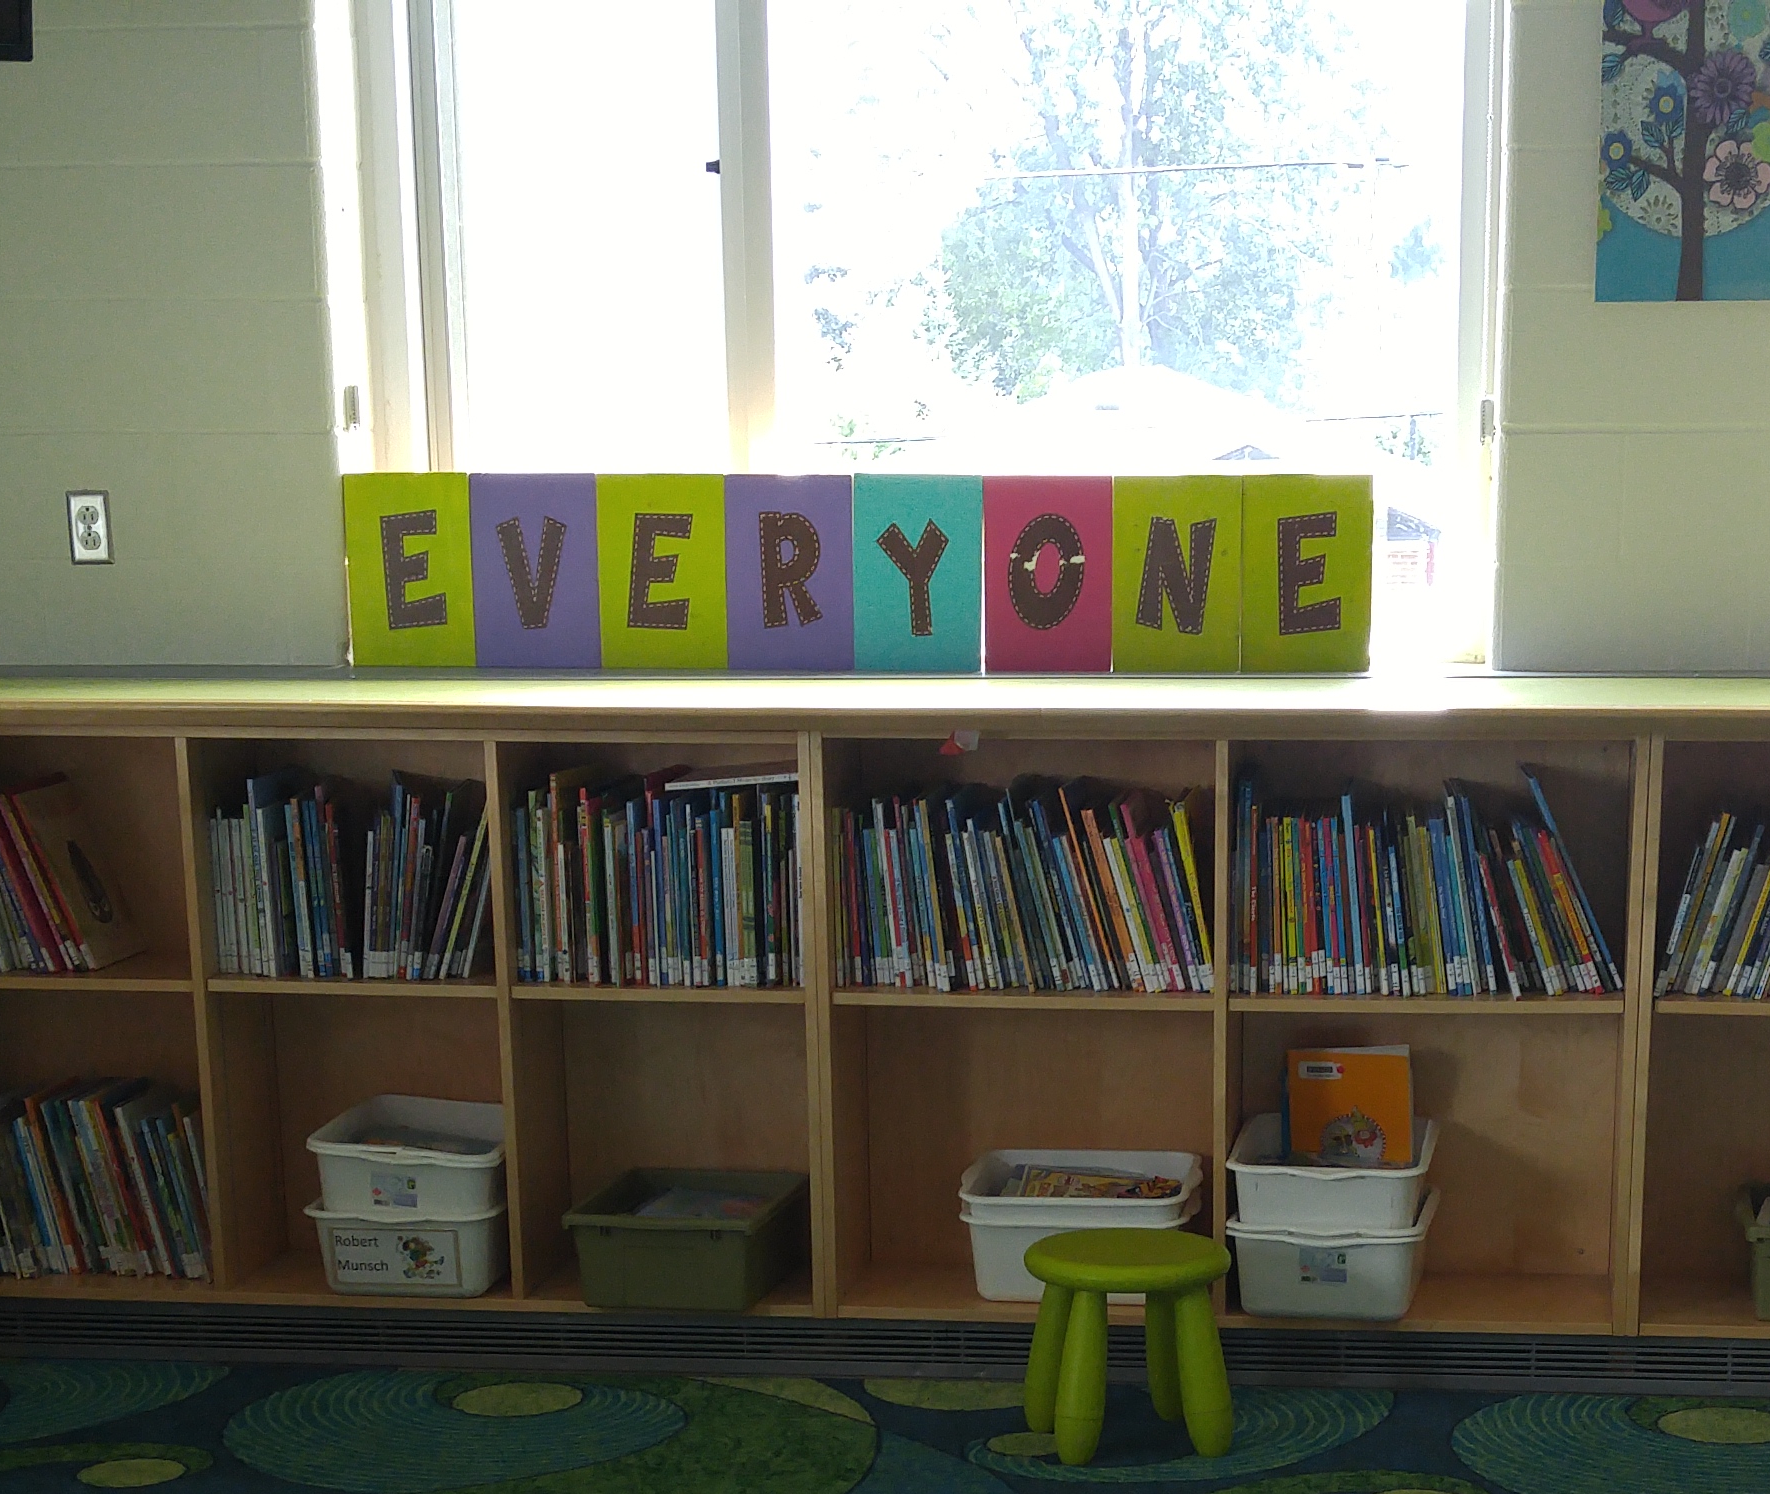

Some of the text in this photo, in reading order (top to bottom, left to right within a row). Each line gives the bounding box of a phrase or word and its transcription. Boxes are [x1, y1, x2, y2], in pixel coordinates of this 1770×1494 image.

[379, 508, 1341, 636] EVERYONE
[335, 1235, 379, 1247] Robert
[337, 1260, 389, 1271] Munsch
